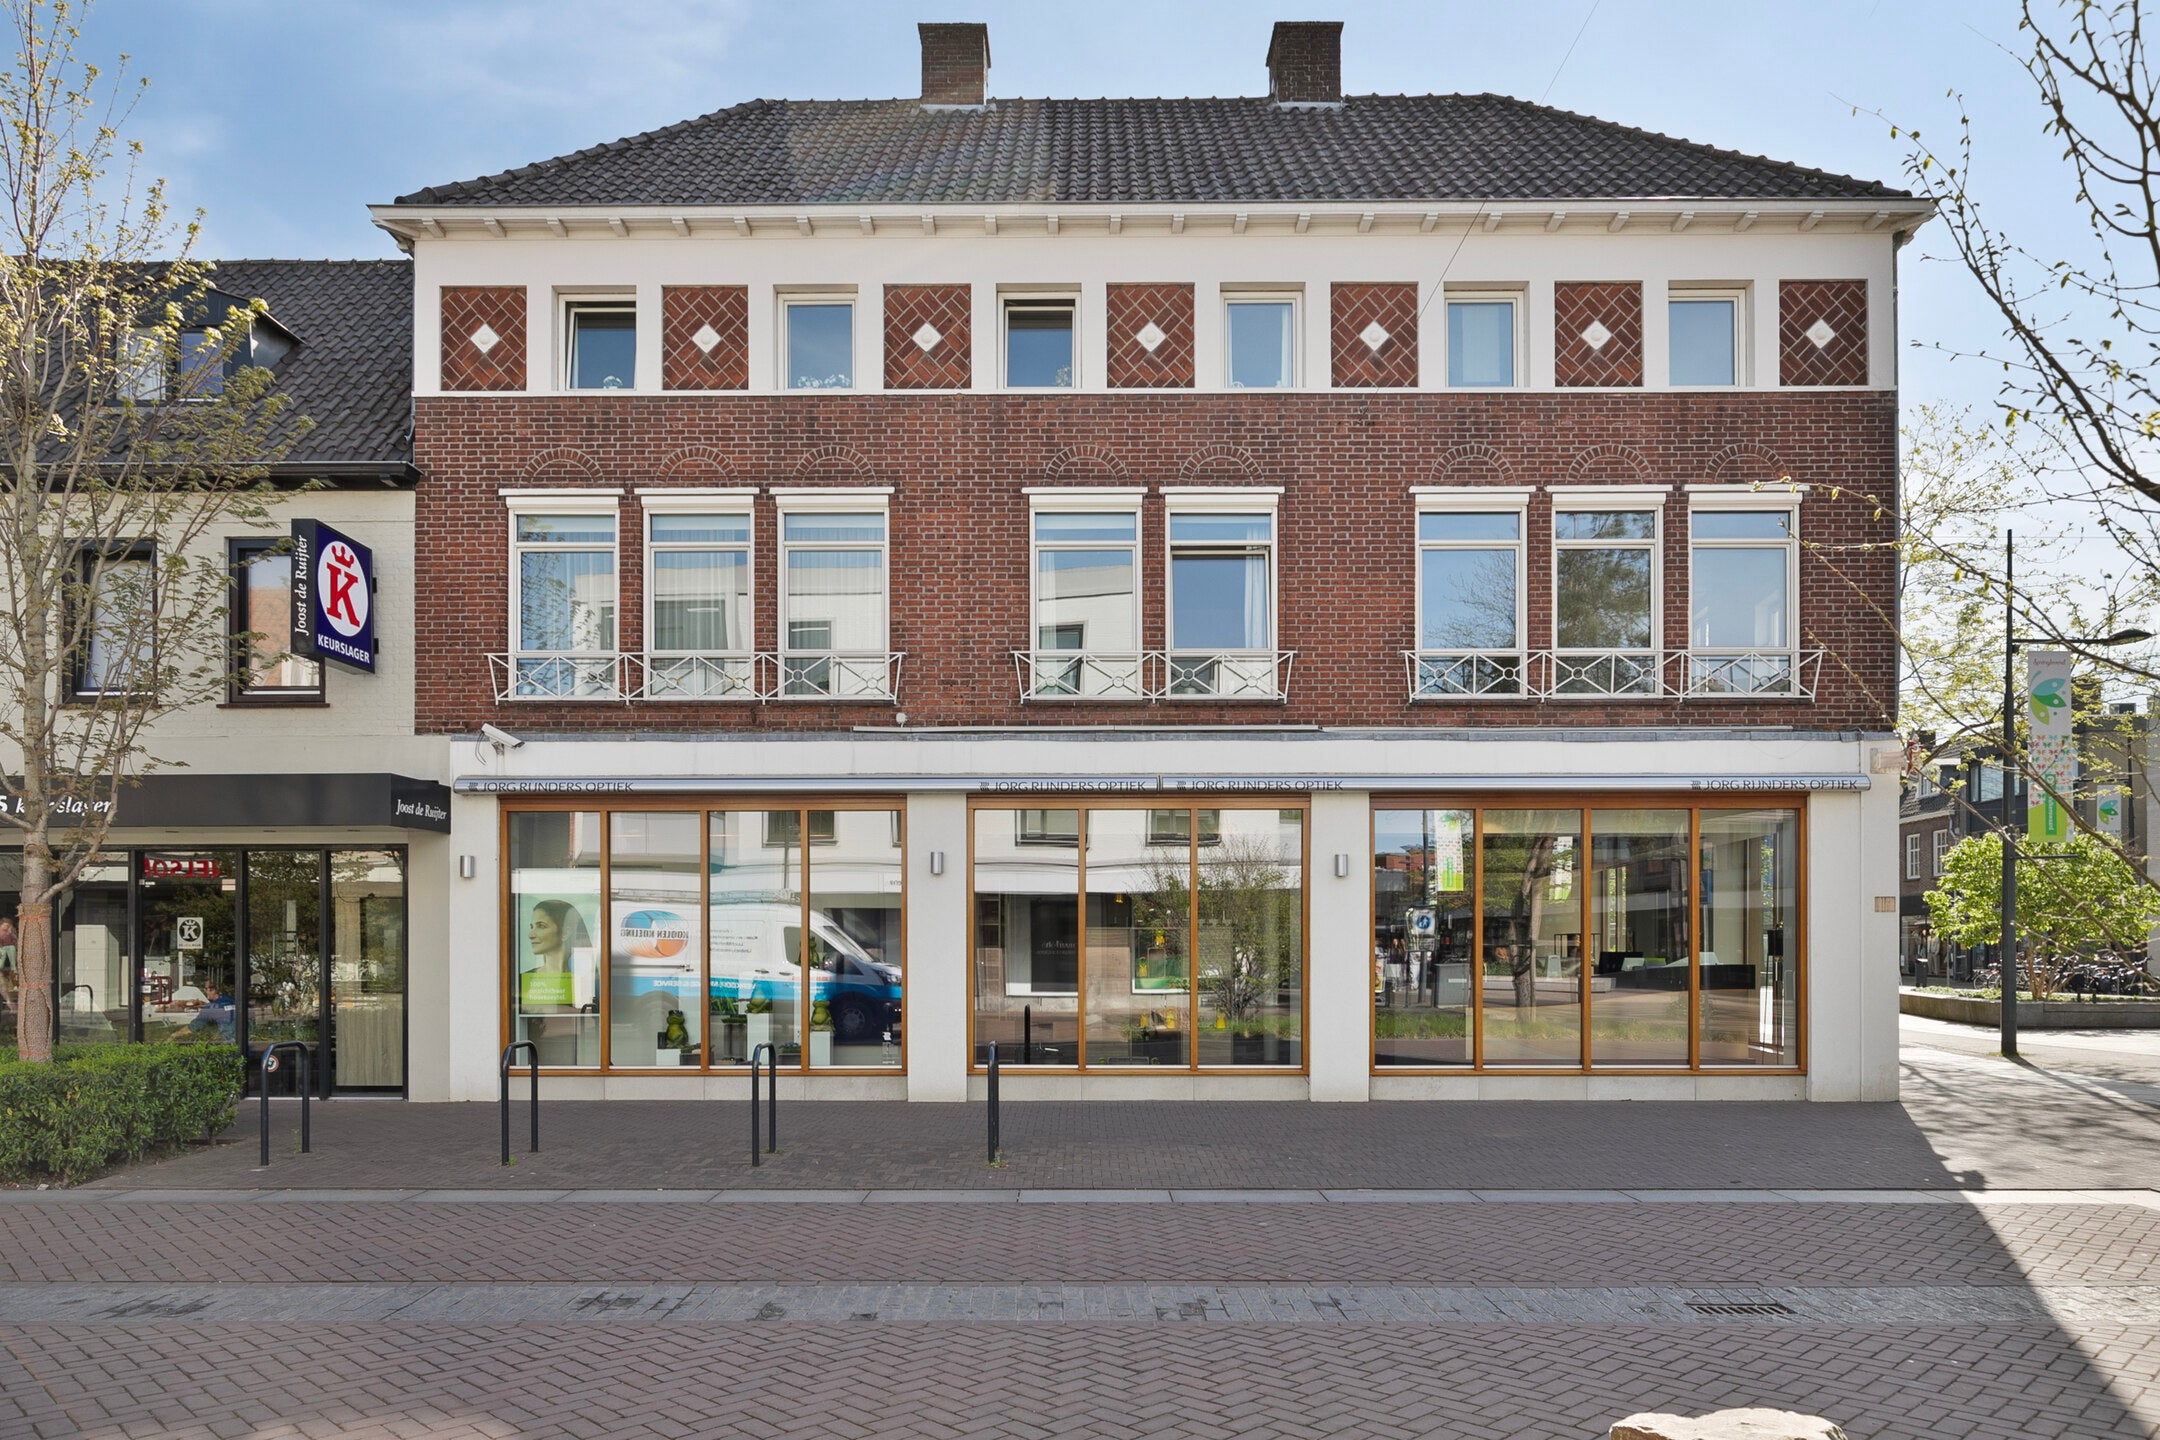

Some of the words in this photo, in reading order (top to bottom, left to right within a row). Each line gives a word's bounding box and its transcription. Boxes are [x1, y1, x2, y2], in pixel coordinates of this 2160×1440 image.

[295, 535, 310, 579] Ruijter
[294, 583, 307, 599] de
[326, 562, 360, 627] K
[294, 602, 309, 636] Joost
[317, 633, 370, 664] KEURSLAGER
[481, 781, 517, 792] JORG
[585, 781, 634, 792] OPTIEK
[993, 781, 1028, 792] JORG
[1097, 781, 1147, 792] OPTIEK
[1190, 780, 1225, 791] JORG
[1295, 780, 1343, 790] OPTIEK
[1704, 779, 1740, 790] JORG
[1809, 779, 1858, 789] OPTIEK
[16, 797, 112, 816] kslaer
[395, 799, 414, 815] Joost
[415, 802, 424, 816] de
[182, 925, 198, 939] K
